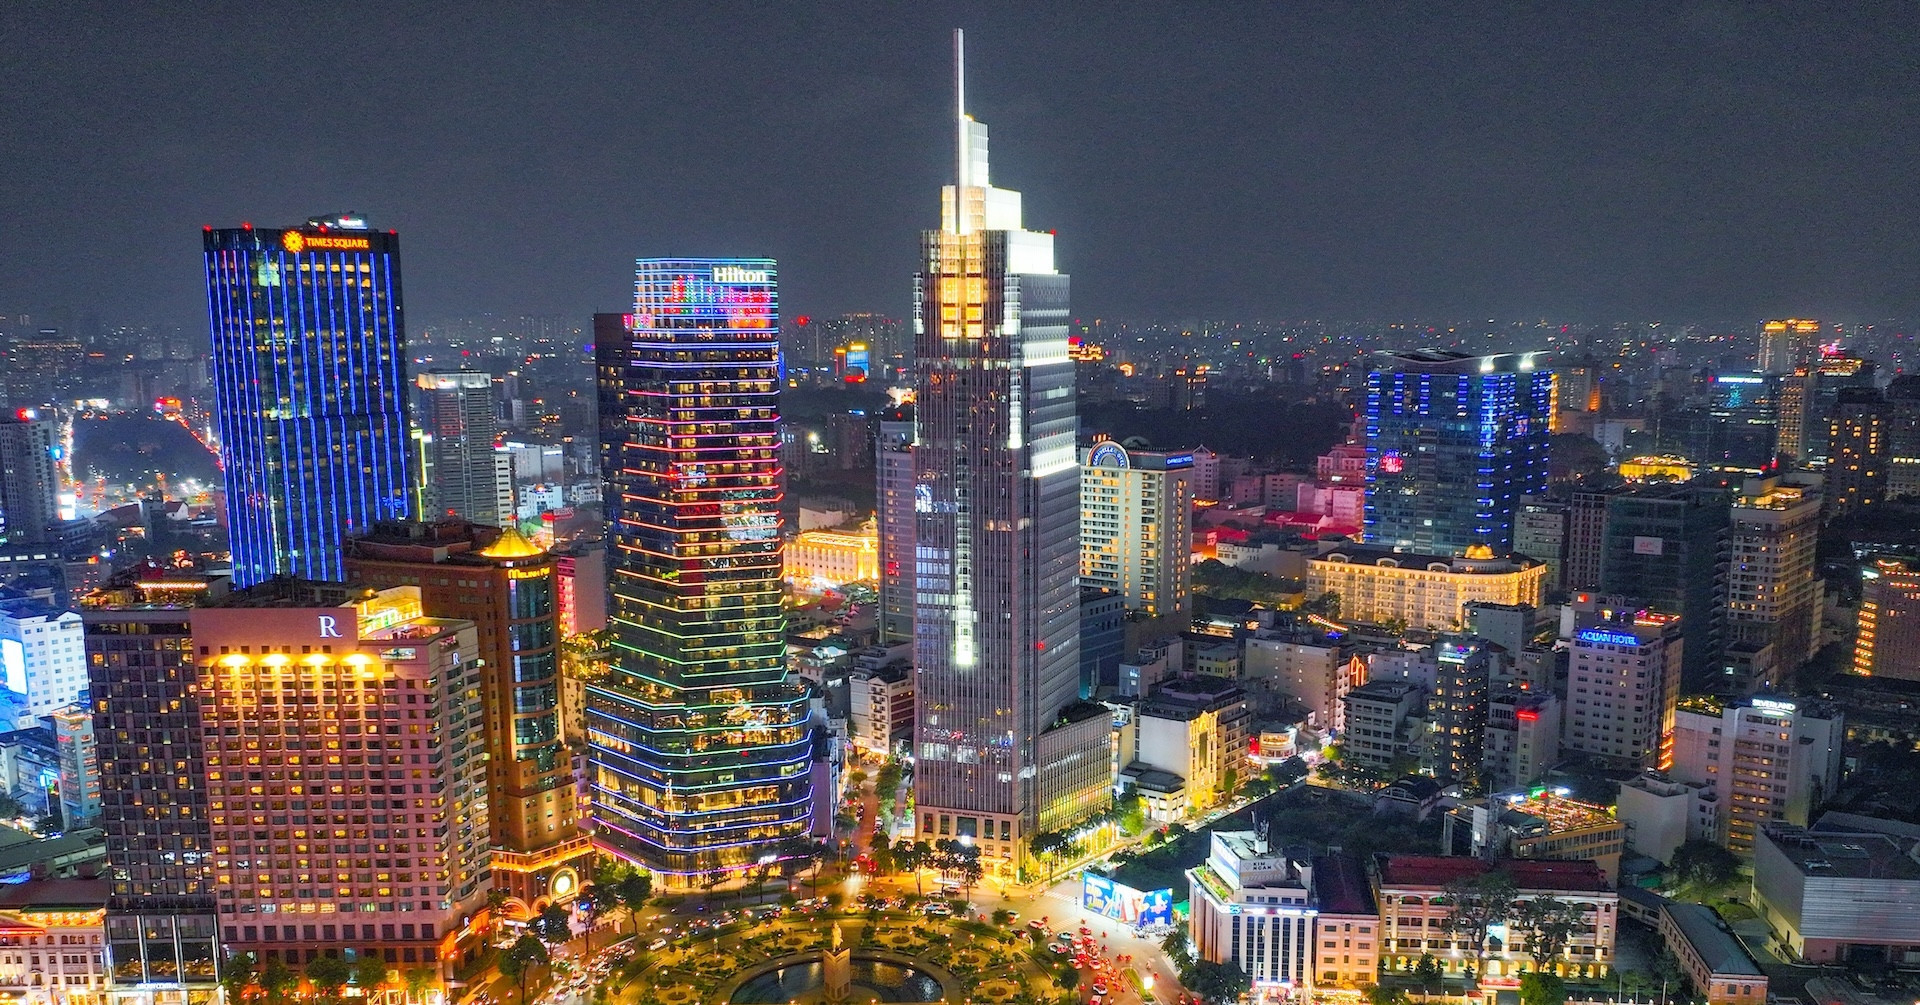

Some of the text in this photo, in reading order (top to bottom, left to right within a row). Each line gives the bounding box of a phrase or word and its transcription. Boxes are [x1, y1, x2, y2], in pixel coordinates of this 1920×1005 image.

[305, 237, 369, 249] TIMES SQUARE
[713, 266, 767, 283] Hilton
[318, 615, 344, 638] R
[1612, 635, 1637, 645] HOTEL
[453, 652, 460, 665] R
